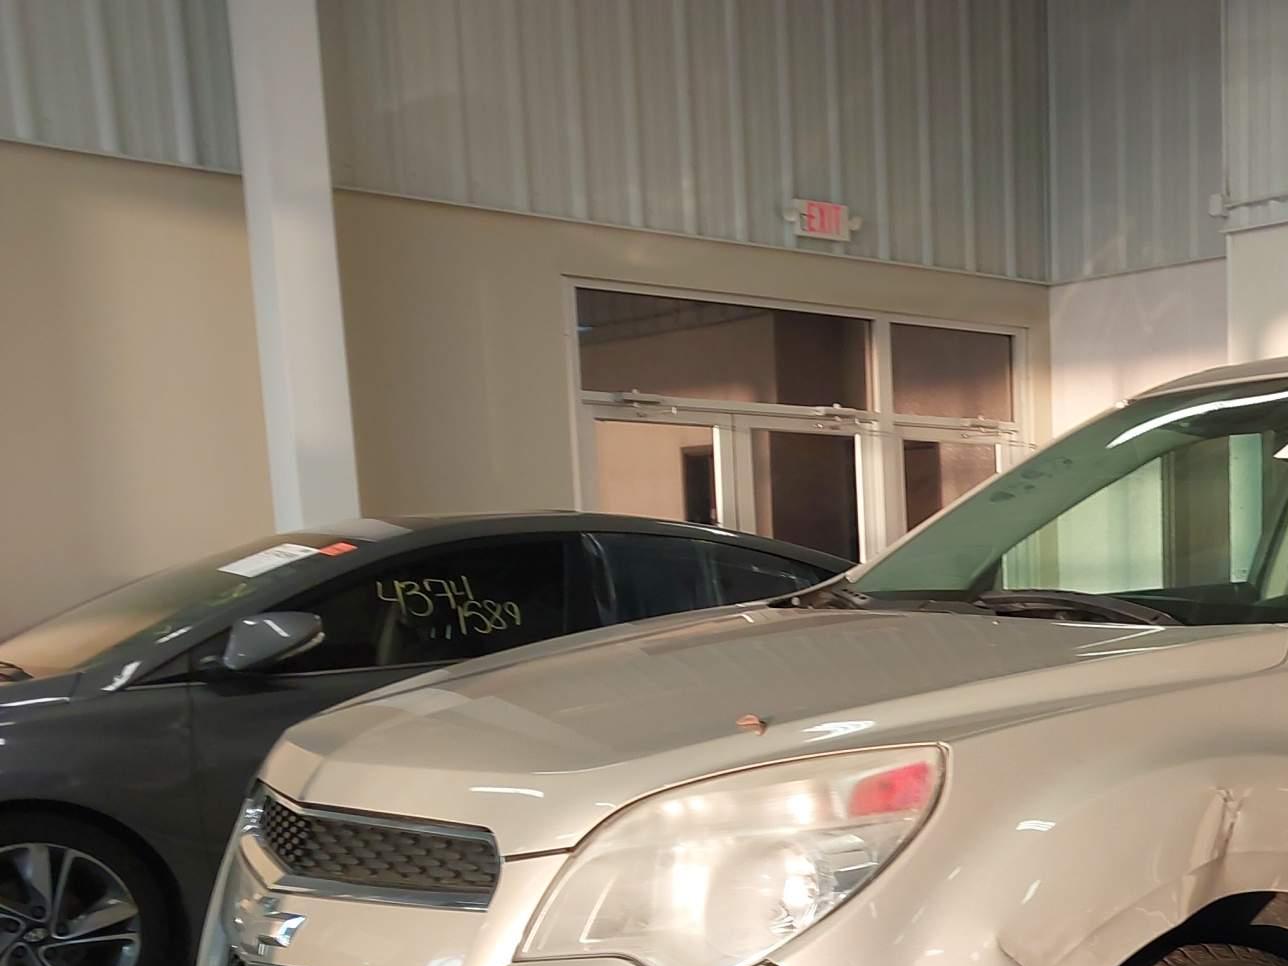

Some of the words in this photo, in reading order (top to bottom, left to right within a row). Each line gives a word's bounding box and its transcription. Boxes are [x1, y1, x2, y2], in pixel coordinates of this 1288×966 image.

[806, 202, 846, 236] EXIT
[376, 575, 474, 617] 4374
[457, 599, 521, 636] 1589
